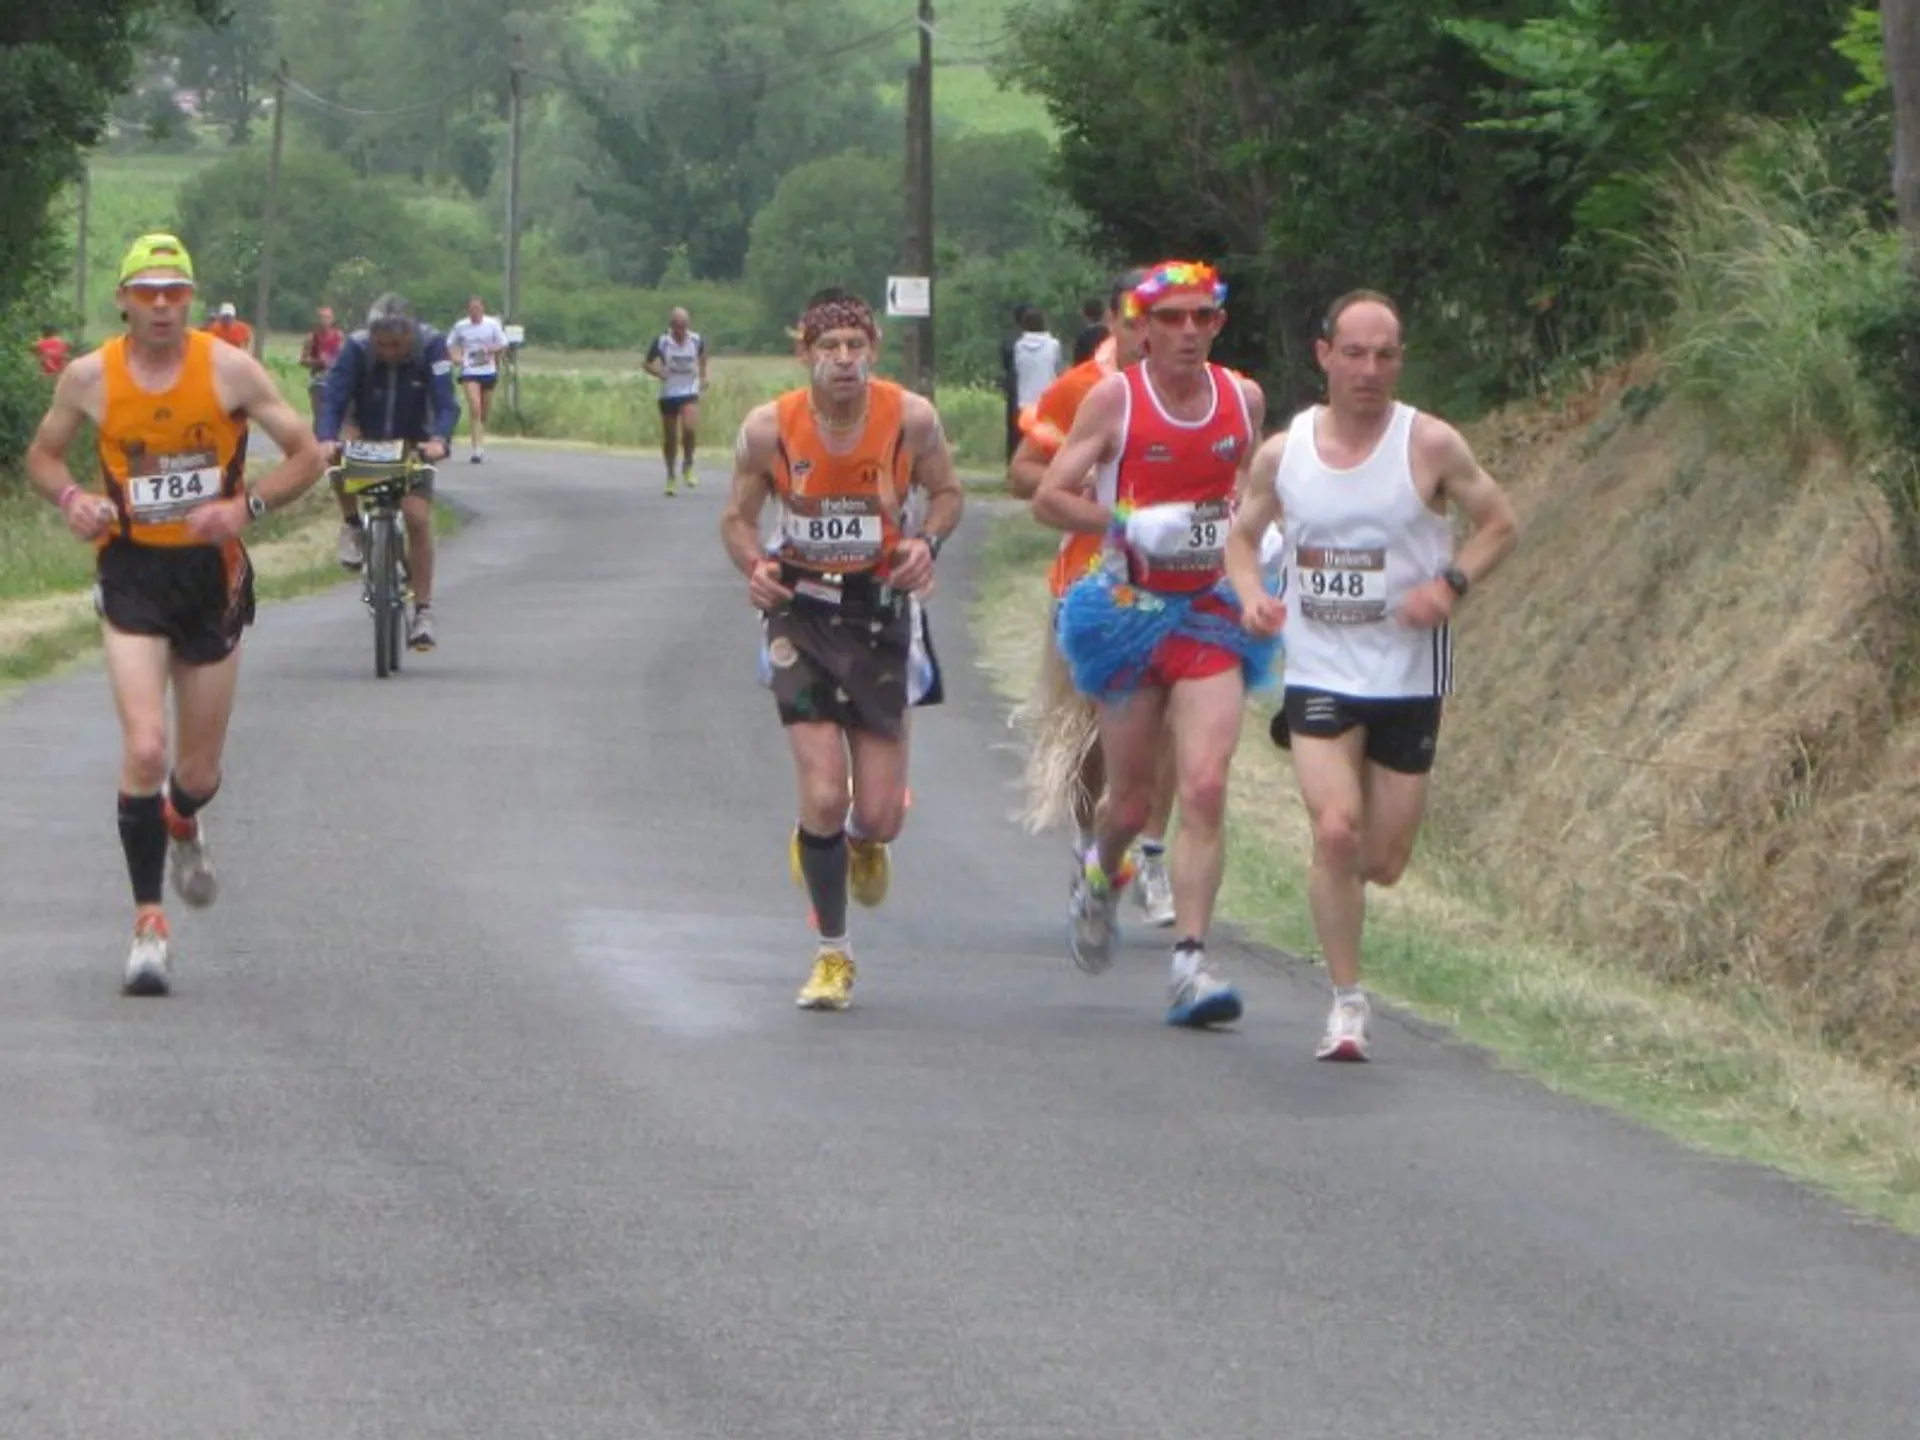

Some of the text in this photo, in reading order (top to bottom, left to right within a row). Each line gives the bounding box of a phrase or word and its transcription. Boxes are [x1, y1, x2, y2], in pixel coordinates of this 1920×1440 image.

[149, 473, 203, 500] 784
[809, 518, 862, 539] 804
[1312, 571, 1364, 597] 948
